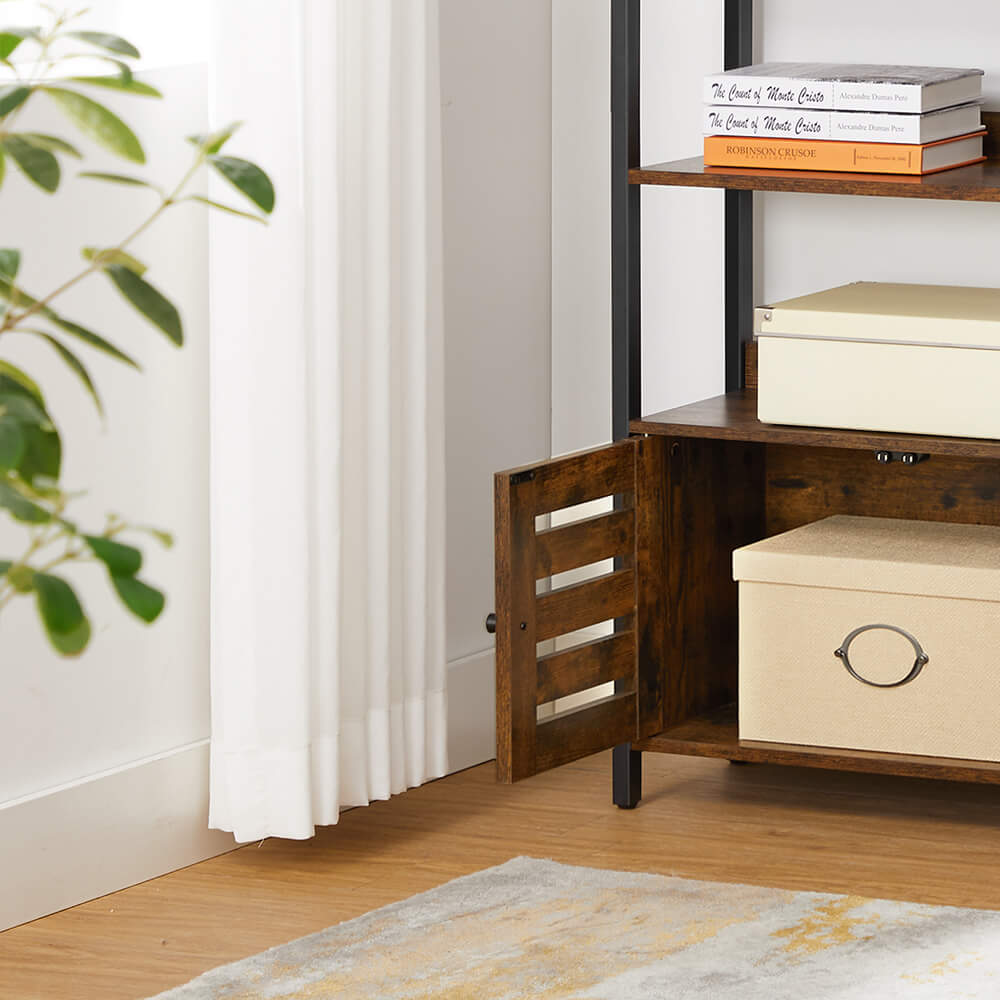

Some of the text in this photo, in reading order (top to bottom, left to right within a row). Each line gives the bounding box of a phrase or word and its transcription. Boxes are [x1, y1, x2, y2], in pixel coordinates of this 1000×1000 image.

[711, 83, 825, 105] The Count of Monte Cristo
[708, 112, 821, 135] The Count of Monte Cristo
[726, 145, 777, 157] ROBINSON
[777, 147, 816, 159] CRUSOE
